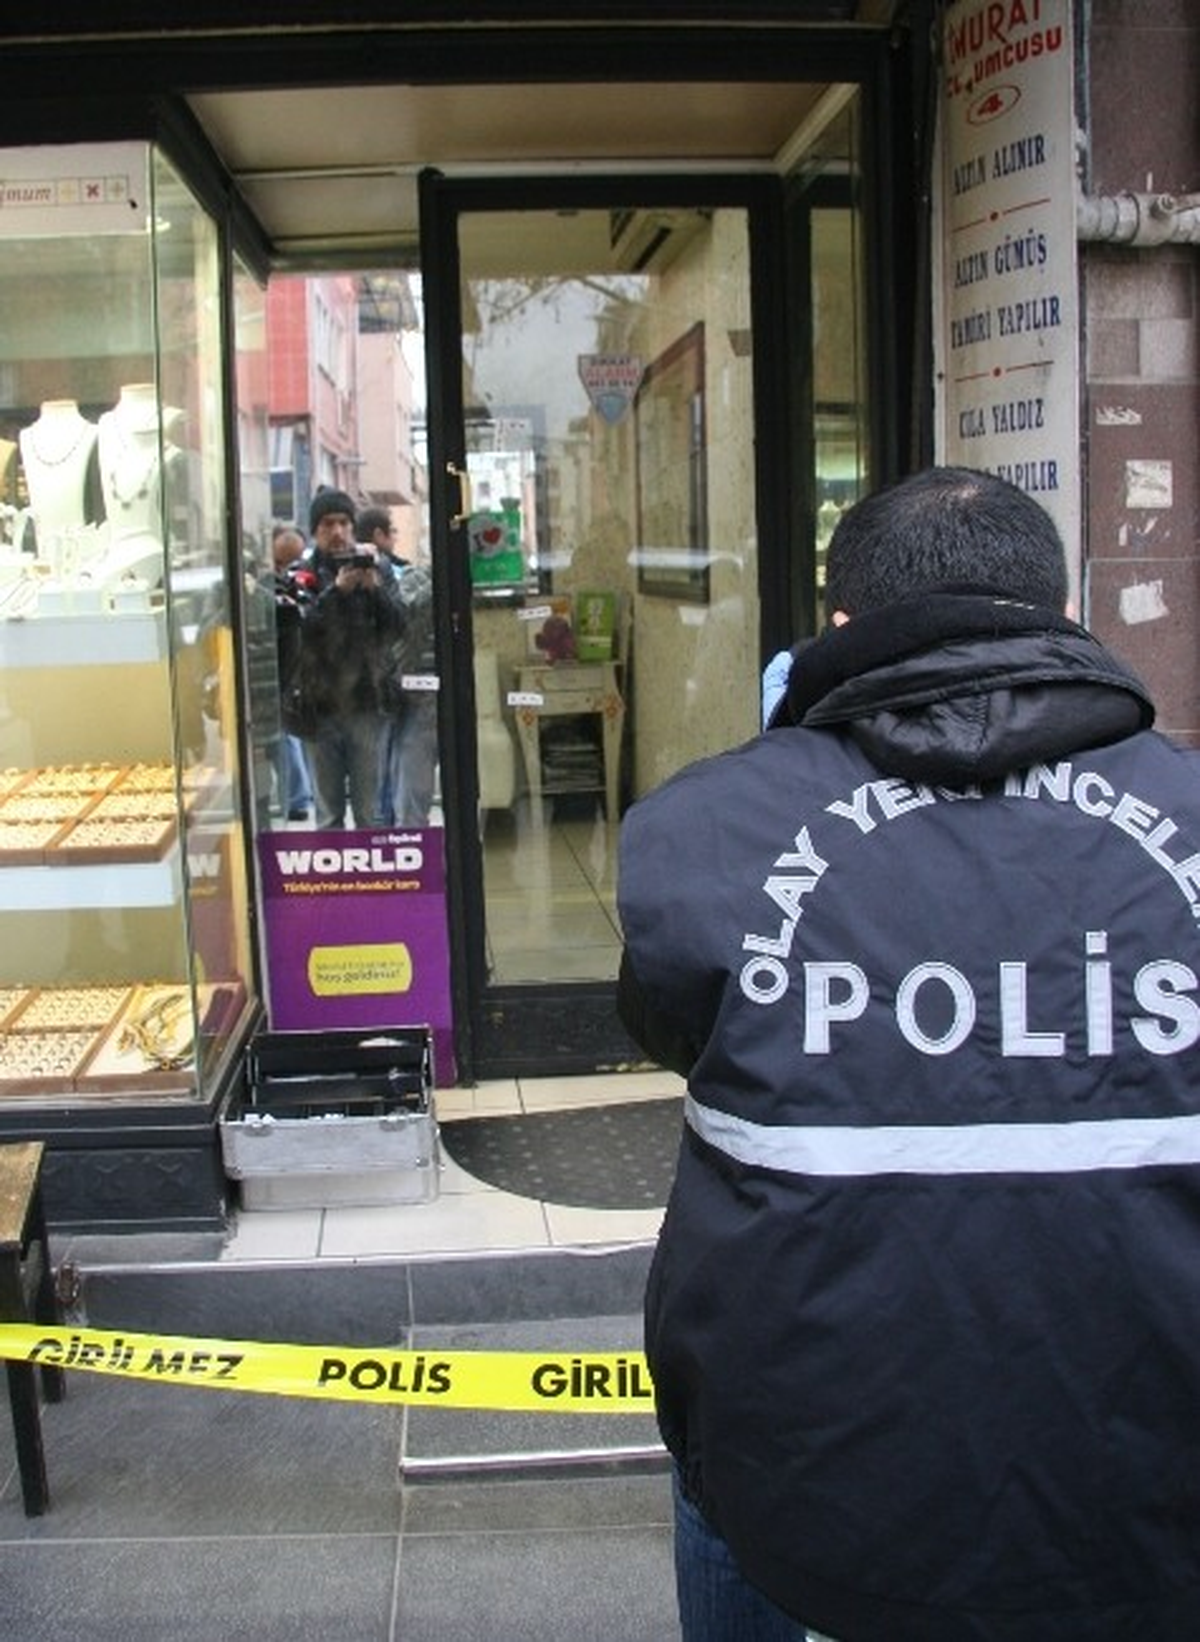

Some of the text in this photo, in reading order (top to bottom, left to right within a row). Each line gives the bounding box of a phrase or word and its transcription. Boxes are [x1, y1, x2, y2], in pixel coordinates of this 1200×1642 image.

[977, 93, 1004, 116] 4
[992, 132, 1046, 179] ALINIR
[955, 228, 1047, 289] ALTIN GÜMÜŞ
[997, 295, 1062, 337] YAPILIR
[992, 397, 1044, 434] YALDIZ
[275, 847, 423, 875] WORLD
[739, 825, 830, 1005] OLAY
[802, 930, 1200, 1057] POLİS
[318, 1356, 452, 1394] POLİS
[532, 1358, 653, 1398] GİRİL
